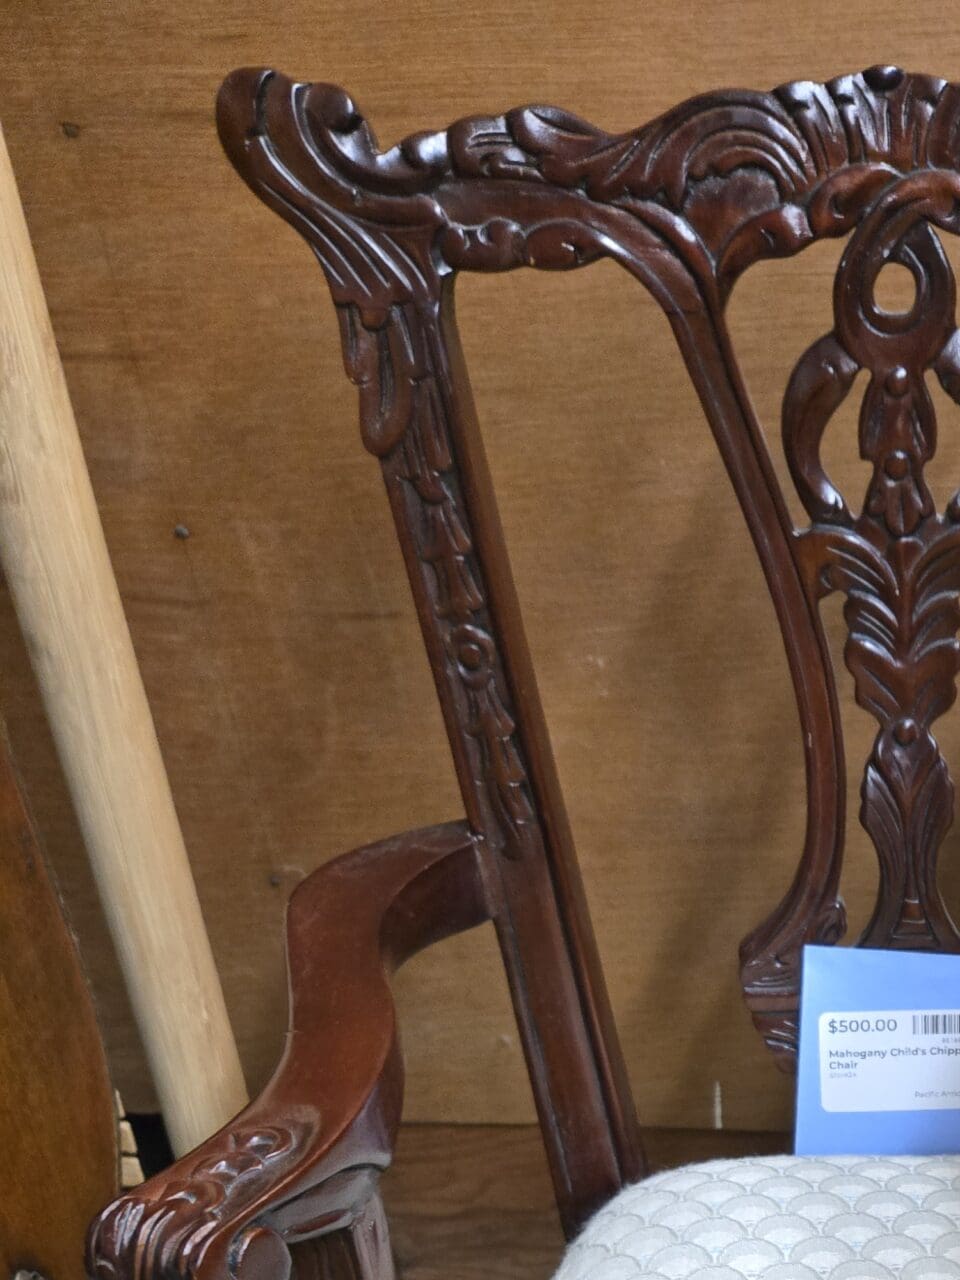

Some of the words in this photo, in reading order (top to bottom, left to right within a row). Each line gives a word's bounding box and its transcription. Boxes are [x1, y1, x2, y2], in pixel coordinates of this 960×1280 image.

[828, 1018, 898, 1034] $500.00
[829, 1049, 887, 1059] Mahogany
[890, 1047, 927, 1056] Child's
[829, 1060, 858, 1070] Chair
